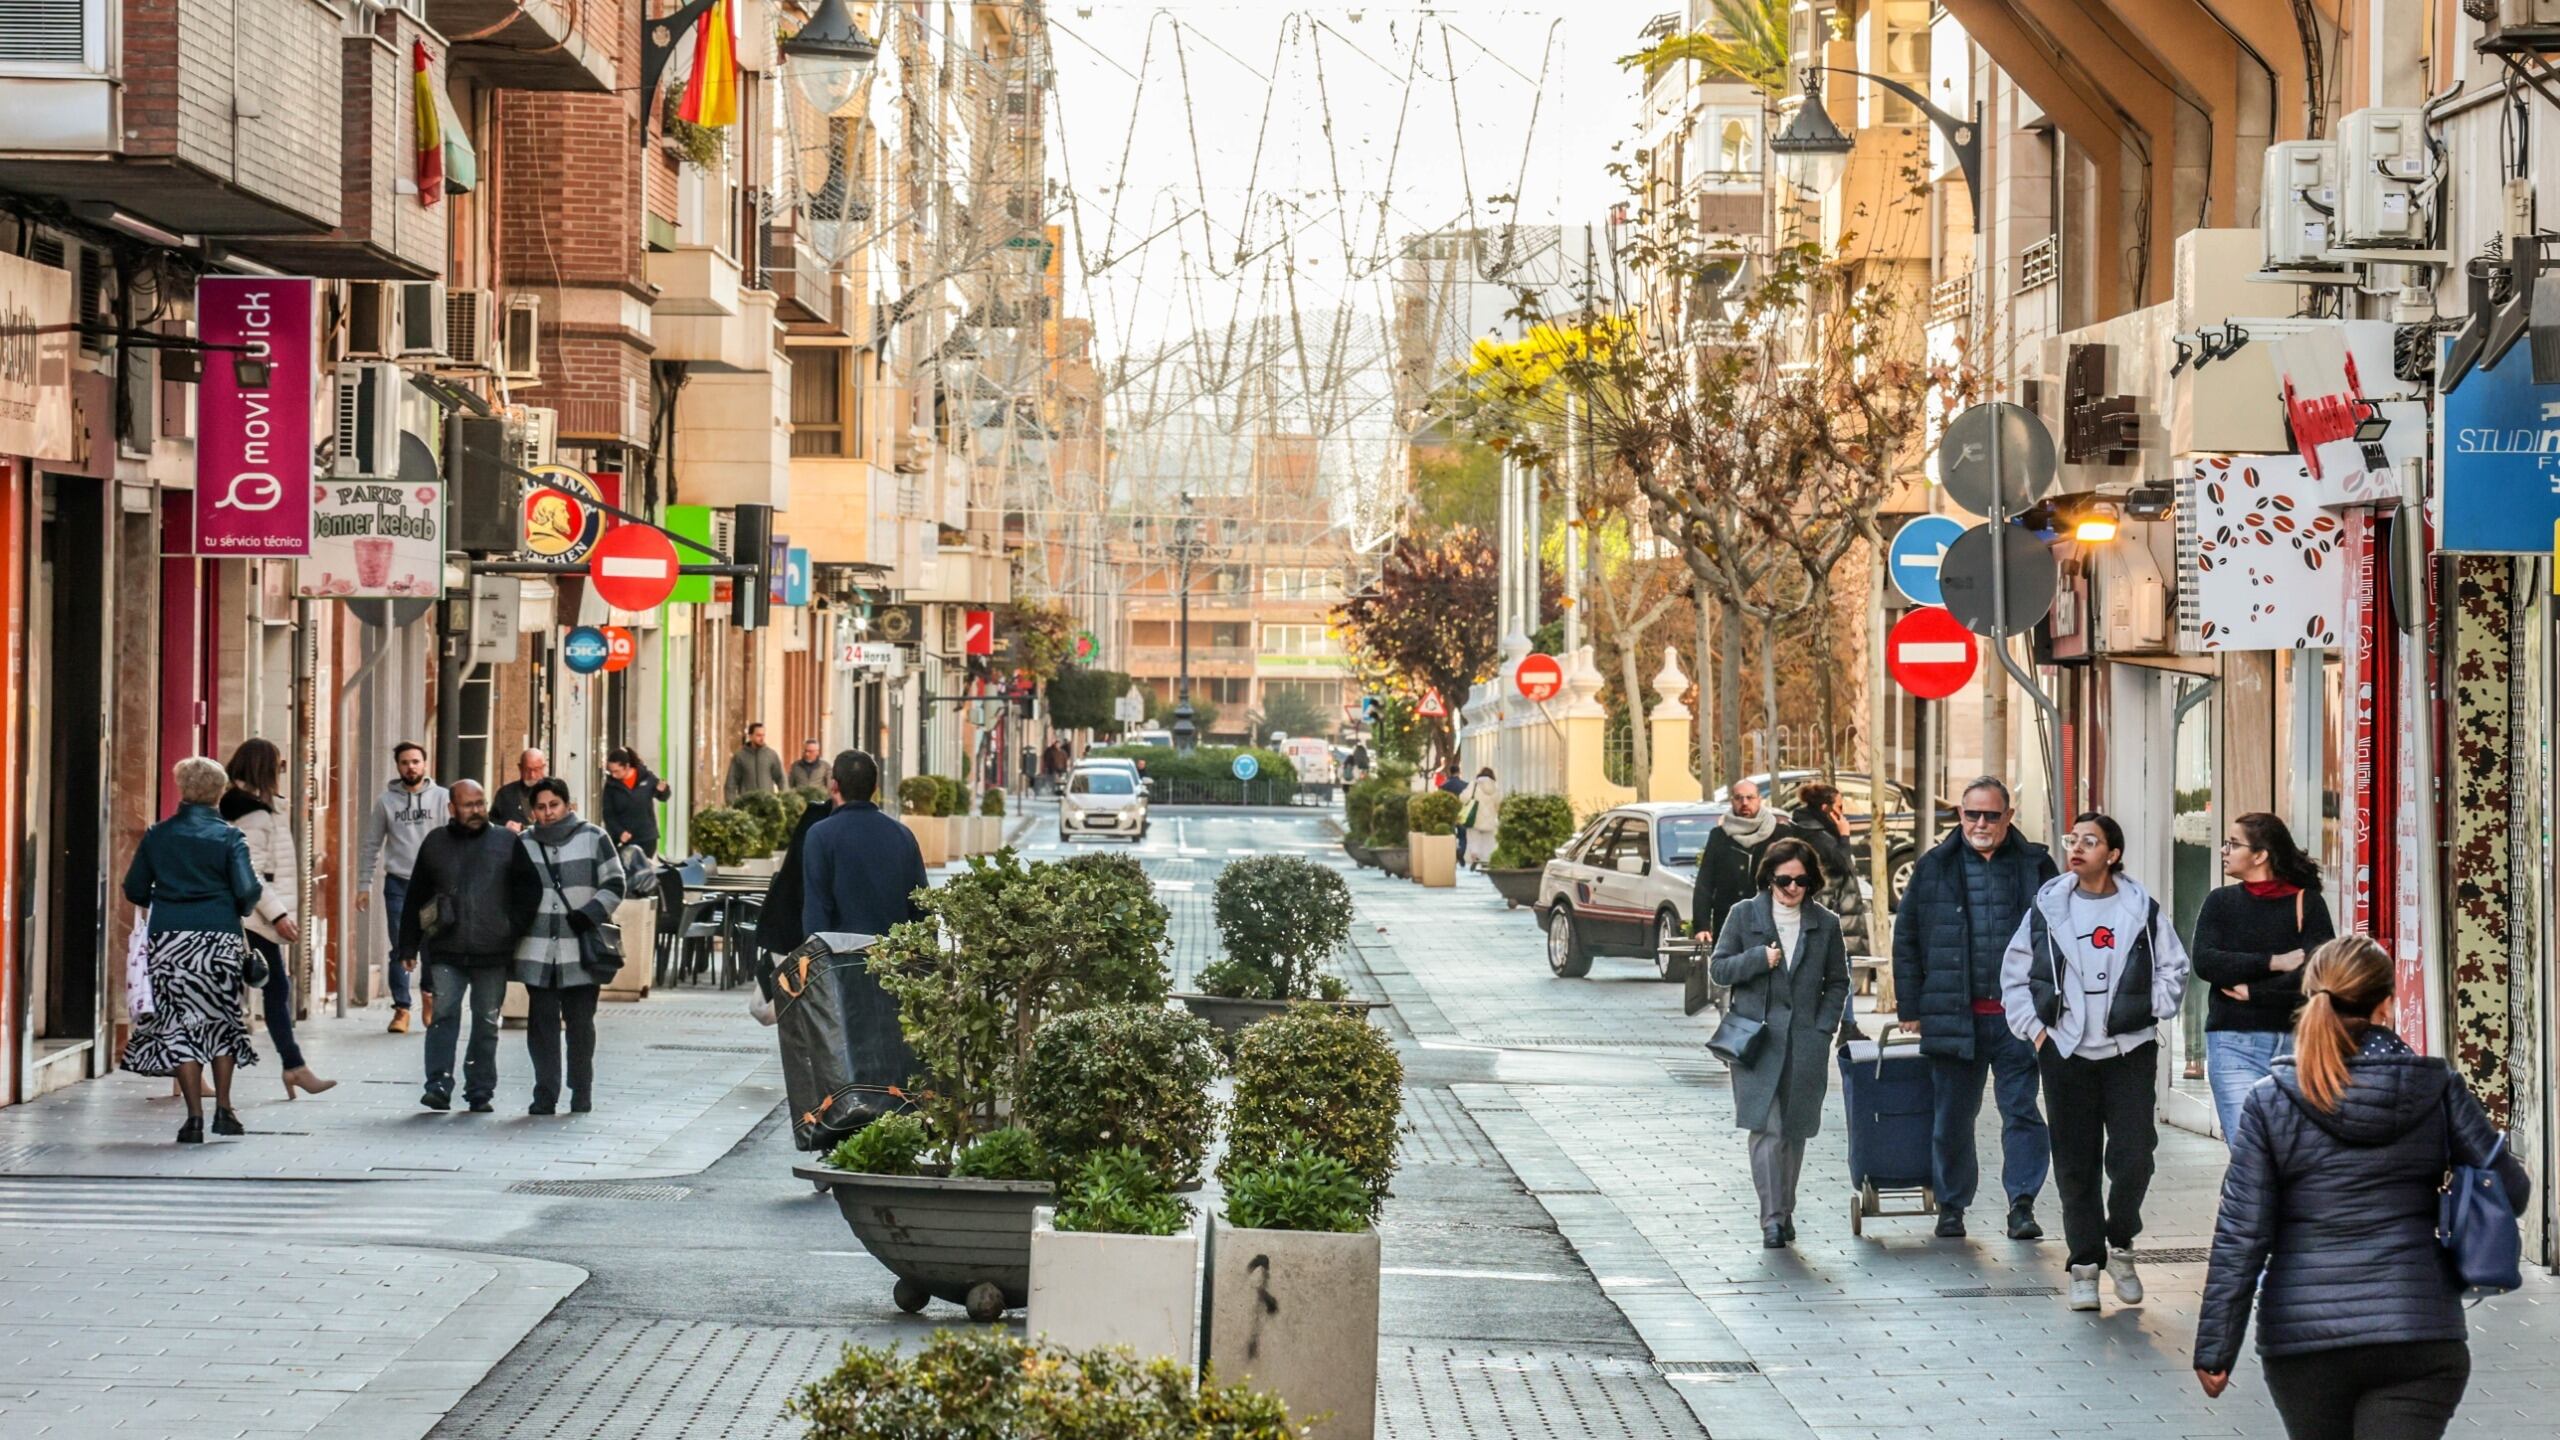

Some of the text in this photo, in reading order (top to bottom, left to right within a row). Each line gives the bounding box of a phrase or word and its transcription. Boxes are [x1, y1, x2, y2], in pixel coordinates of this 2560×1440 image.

[238, 292, 279, 463] moviuick
[336, 485, 404, 506] PARIS
[377, 503, 436, 541] kebab
[205, 536, 217, 547] tu
[264, 535, 303, 547] técnico
[607, 631, 631, 655] ia
[845, 646, 891, 662] 24 Horas
